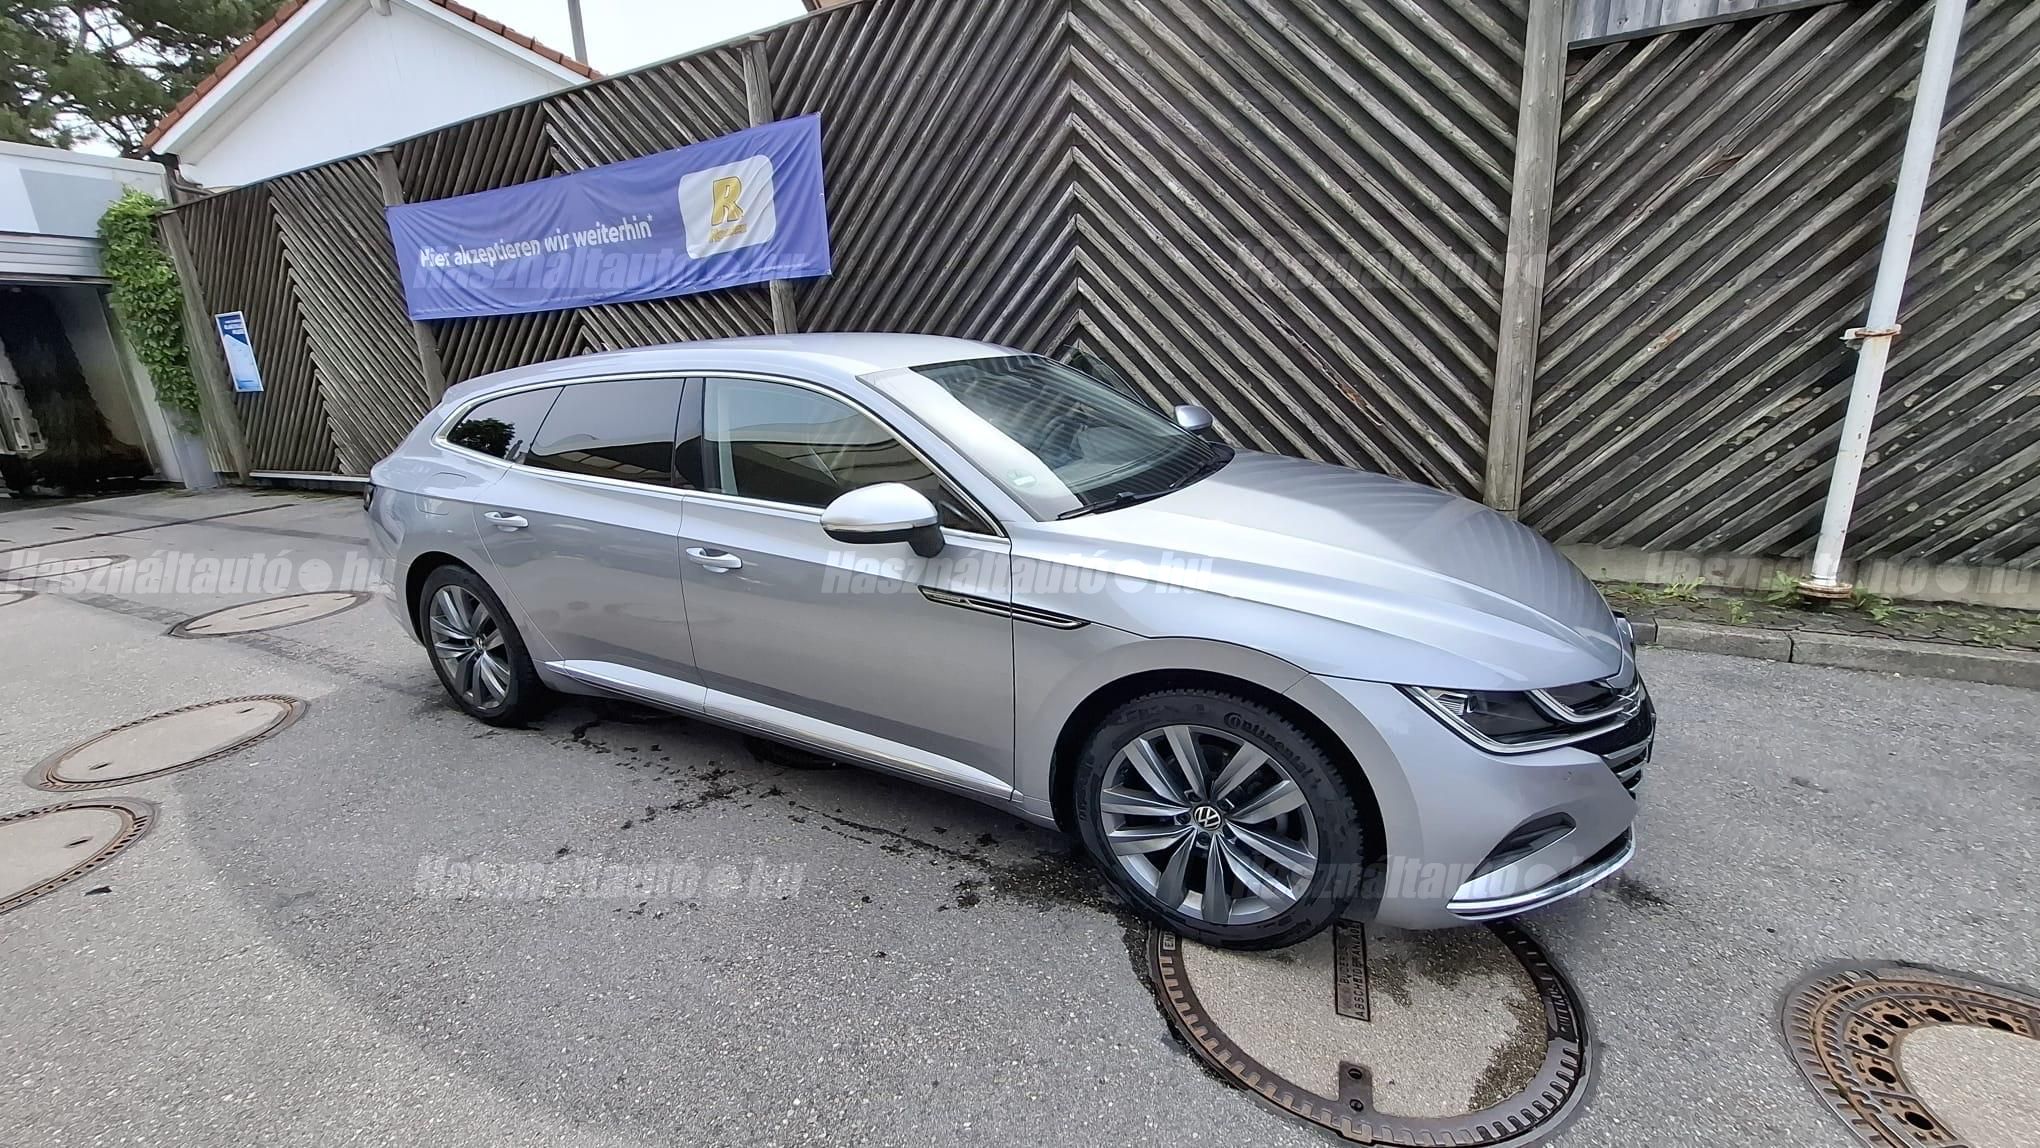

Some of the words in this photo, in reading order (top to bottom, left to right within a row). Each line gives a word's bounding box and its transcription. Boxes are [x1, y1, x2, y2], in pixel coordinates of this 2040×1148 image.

[711, 176, 743, 226] R
[420, 246, 450, 268] Hier
[454, 238, 541, 268] akzeptieren
[544, 227, 569, 253] wir
